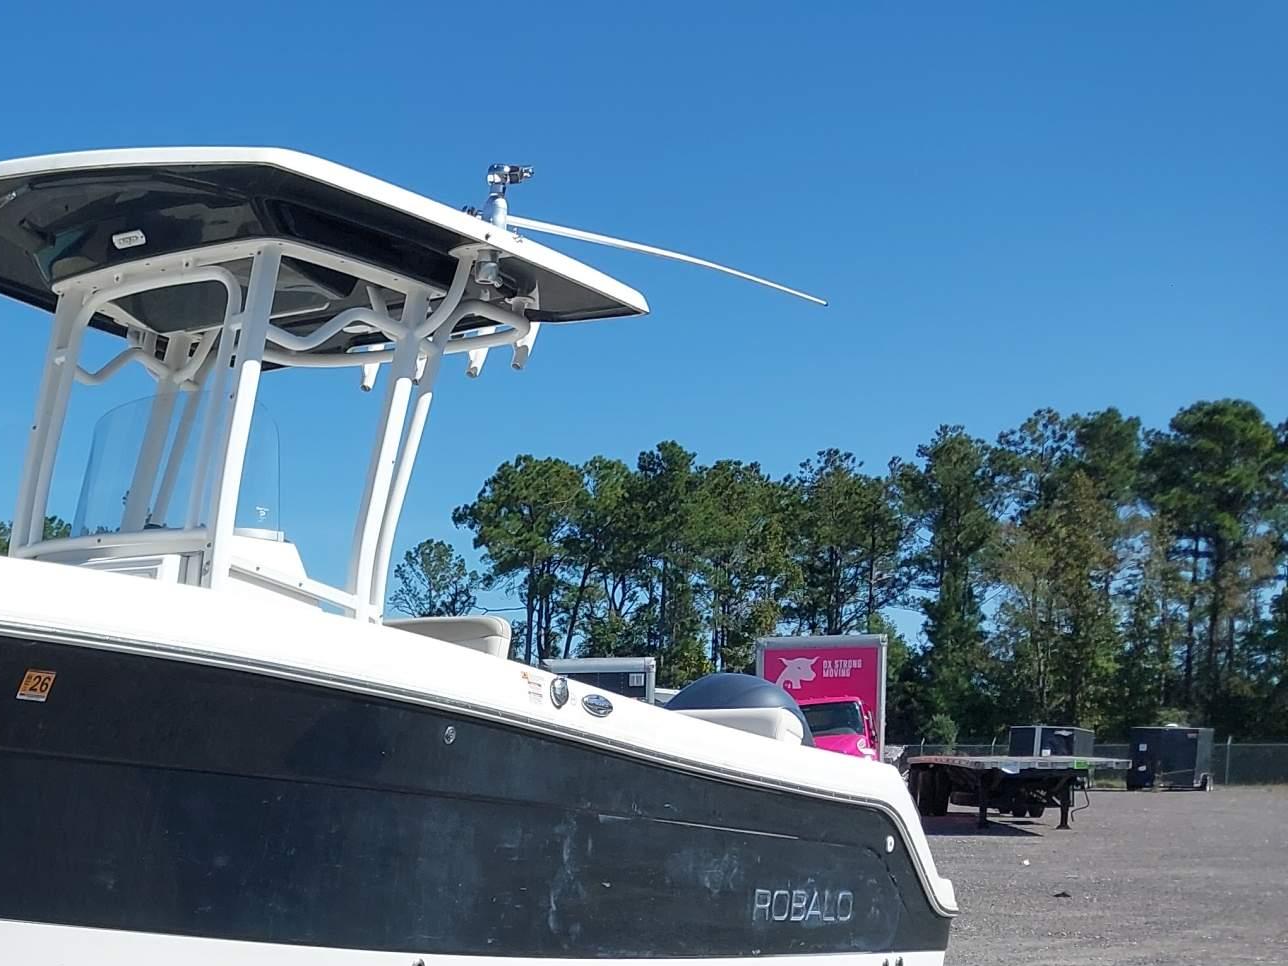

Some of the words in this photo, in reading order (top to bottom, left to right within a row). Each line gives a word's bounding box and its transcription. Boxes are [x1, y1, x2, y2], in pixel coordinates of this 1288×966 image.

[834, 659, 862, 668] STRONG
[823, 668, 851, 678] MOVING
[29, 675, 52, 694] 26
[753, 889, 853, 921] ROBALO
